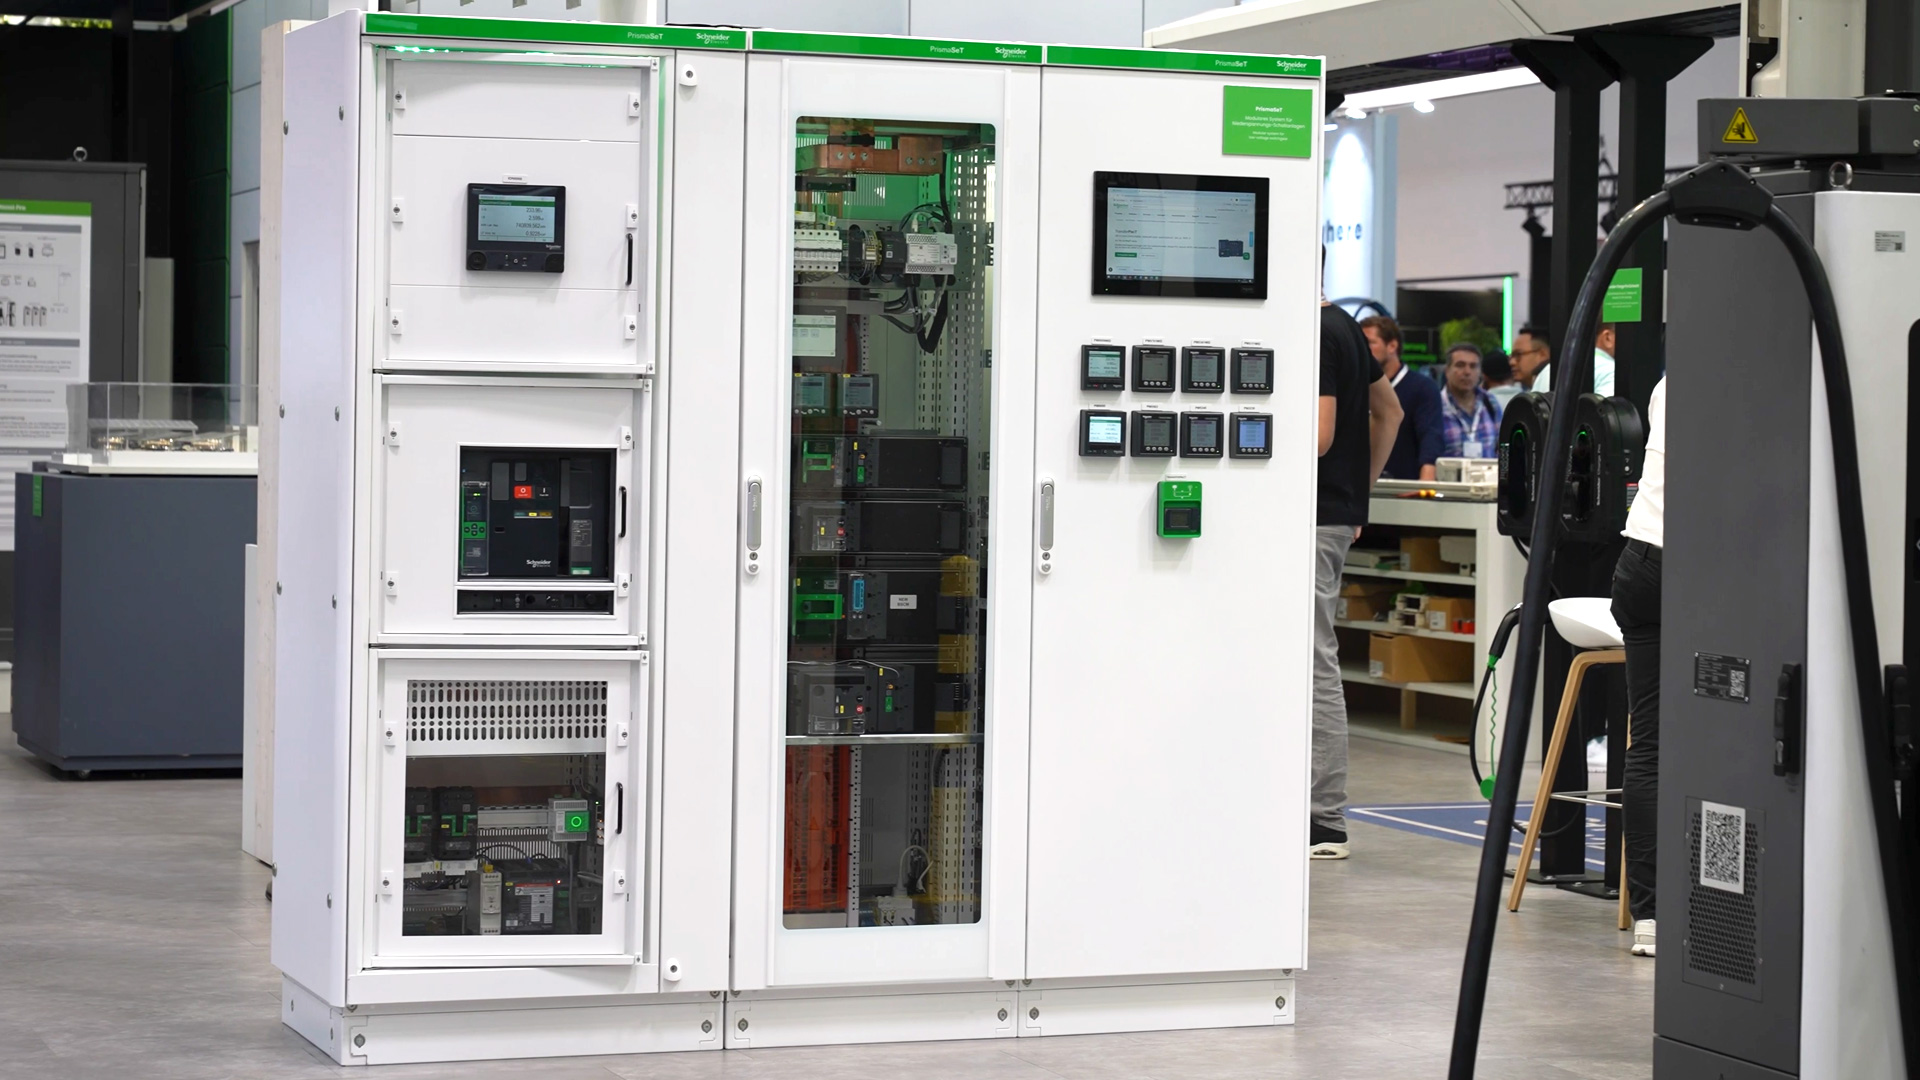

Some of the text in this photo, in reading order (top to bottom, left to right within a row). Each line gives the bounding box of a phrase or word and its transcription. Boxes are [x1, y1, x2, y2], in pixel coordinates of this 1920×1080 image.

[627, 31, 663, 40] PrismaSeT
[696, 32, 730, 42] Schneider
[930, 45, 964, 54] PrismaSeT
[995, 46, 1027, 56] Schneider
[1215, 59, 1247, 68] PrismaSeT
[1276, 60, 1307, 69] Schneider
